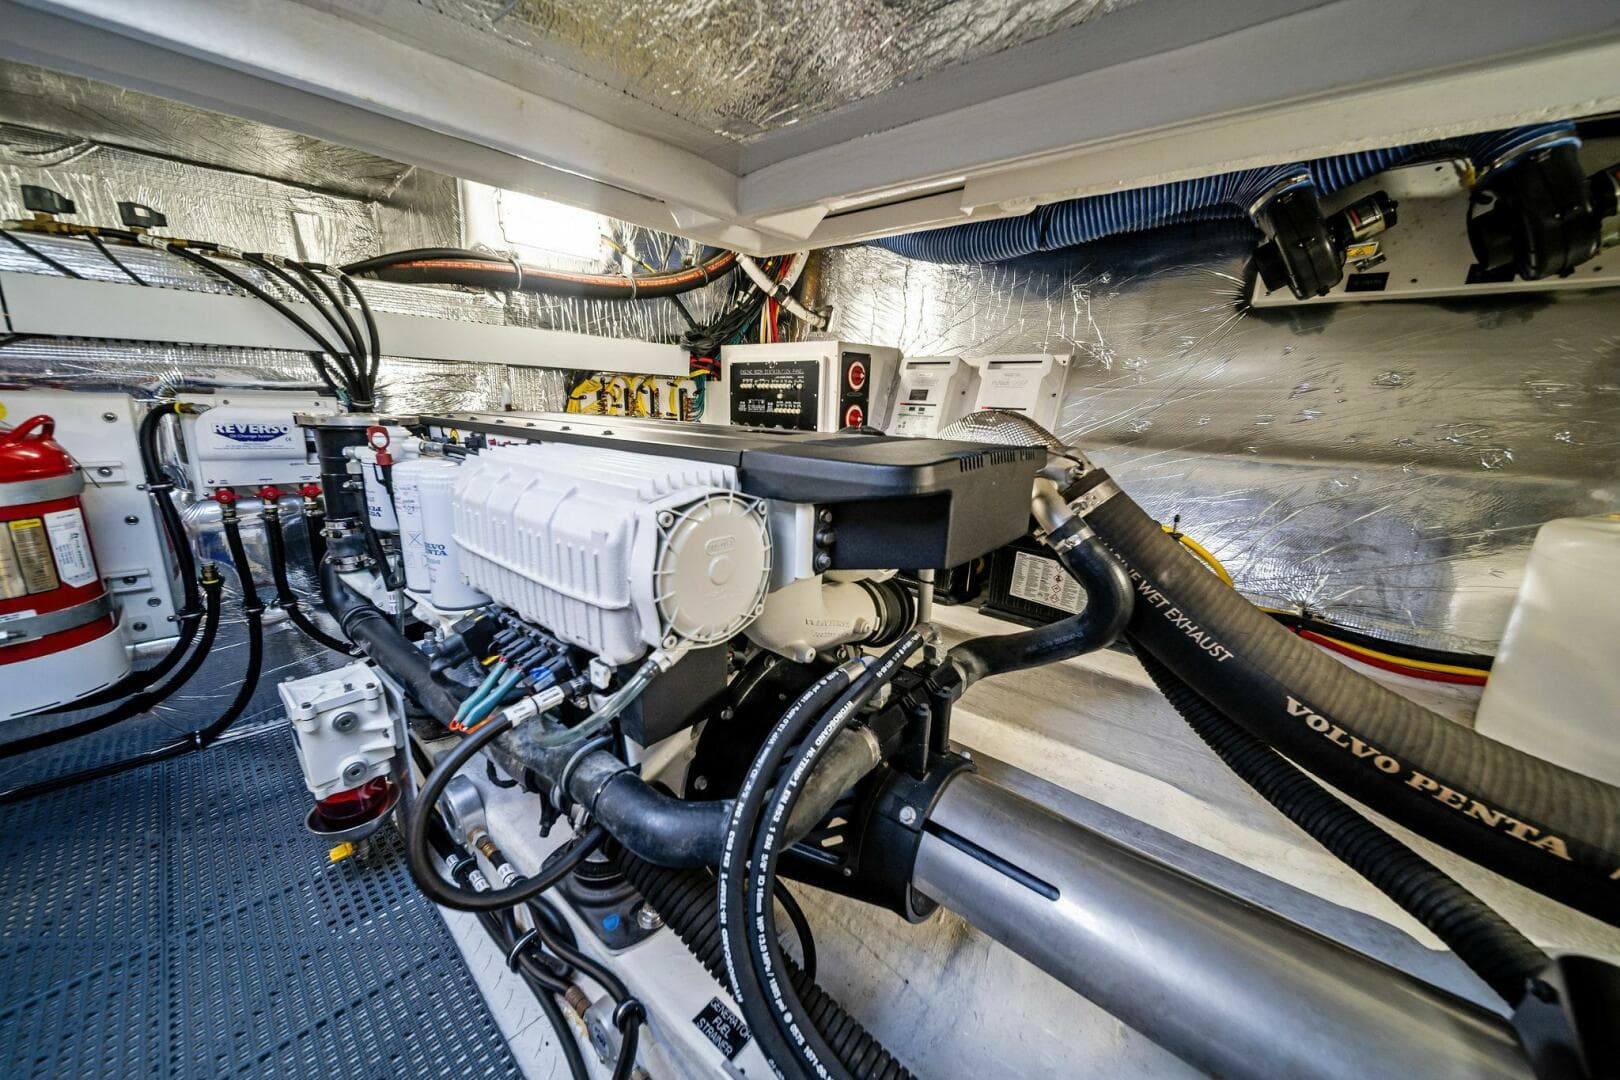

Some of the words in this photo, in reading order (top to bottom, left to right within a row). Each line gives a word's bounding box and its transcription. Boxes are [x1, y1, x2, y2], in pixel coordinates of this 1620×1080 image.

[213, 423, 290, 434] REVERSO
[1137, 581, 1170, 608] WET
[1164, 608, 1234, 662] EXHAUST
[815, 700, 854, 746] HYDROSCAND
[780, 789, 791, 804] EN
[1286, 695, 1400, 774] VOLVO
[1405, 770, 1573, 862] PENTA
[756, 915, 765, 933] WP
[697, 1017, 733, 1056] STRAINER
[710, 999, 752, 1041] GENERATOR
[712, 1016, 731, 1039] FUEL
